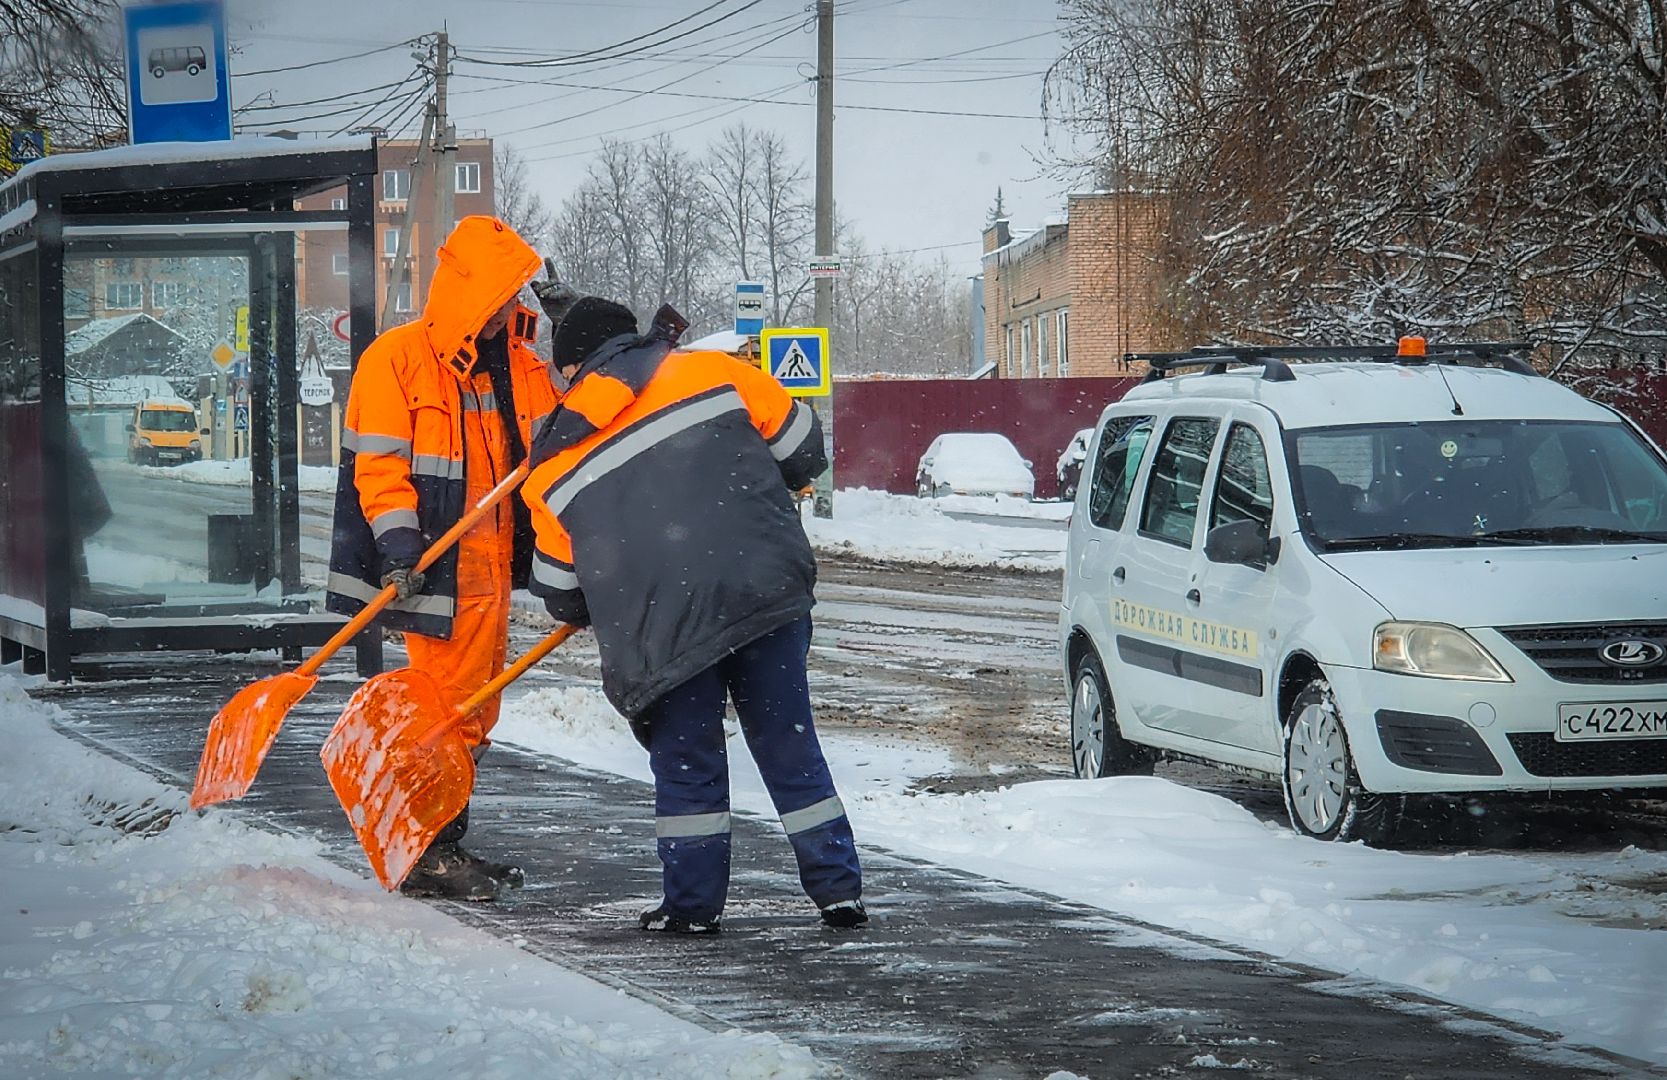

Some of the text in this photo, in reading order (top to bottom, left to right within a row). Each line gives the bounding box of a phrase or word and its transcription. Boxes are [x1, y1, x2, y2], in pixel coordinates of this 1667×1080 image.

[1114, 600, 1249, 653] ДОРОЖНАЯ СЛУЖБА
[1567, 707, 1667, 734] С422ХМ
